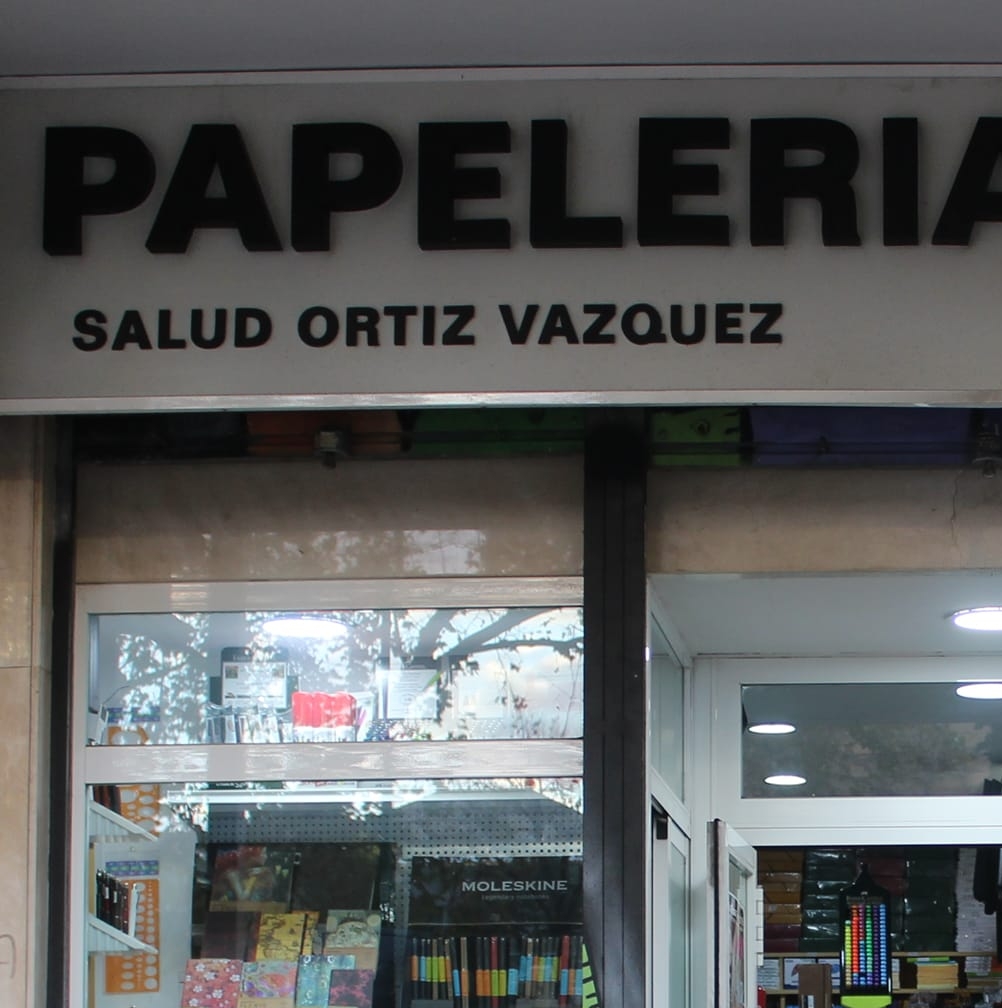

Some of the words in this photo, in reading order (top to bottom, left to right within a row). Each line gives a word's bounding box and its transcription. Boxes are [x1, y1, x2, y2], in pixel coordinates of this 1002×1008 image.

[72, 306, 273, 352] SALUD
[297, 304, 476, 348] ORTIZ
[498, 302, 784, 346] VAZQUEZ
[461, 880, 568, 892] MOLESKINE
